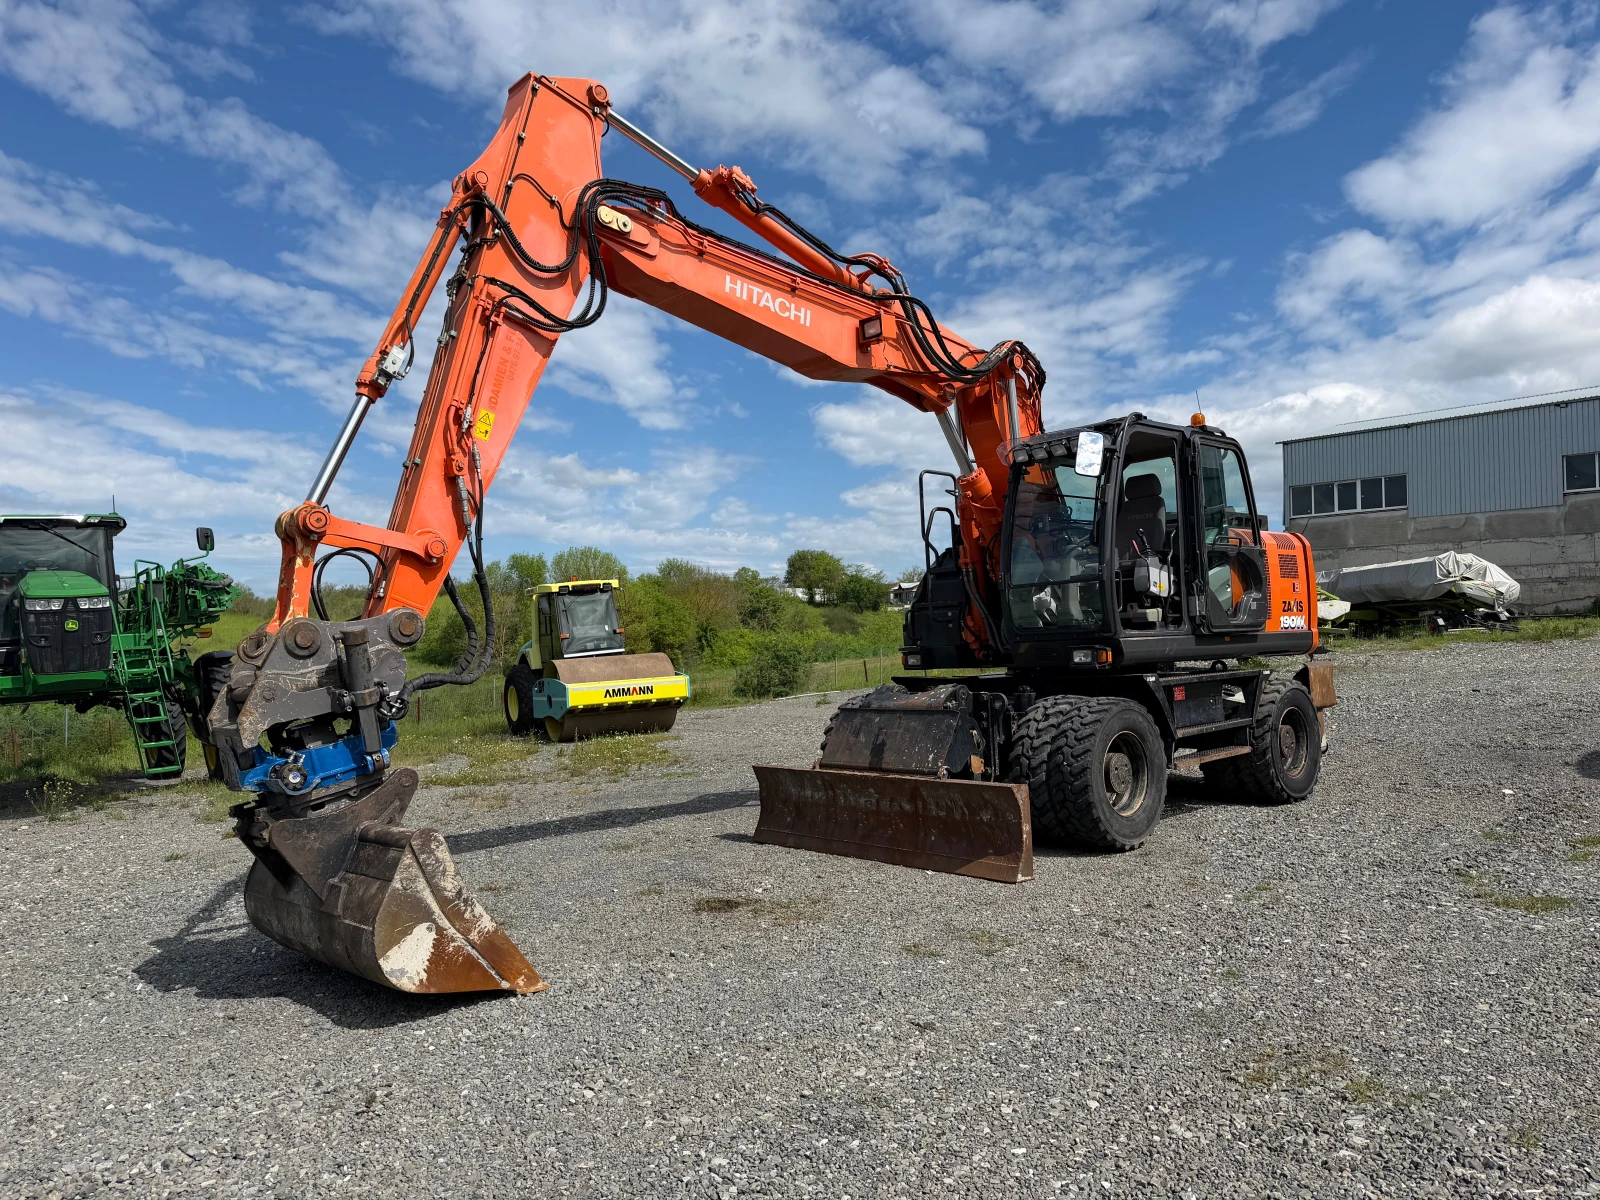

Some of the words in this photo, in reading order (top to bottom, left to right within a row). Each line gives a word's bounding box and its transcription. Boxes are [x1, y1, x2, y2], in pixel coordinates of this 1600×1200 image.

[725, 274, 811, 327] HITACHI
[512, 349, 520, 360] 97
[488, 357, 509, 406] DAMIEN
[502, 346, 512, 355] &
[507, 360, 518, 381] 0476
[1281, 598, 1304, 612] ZAXIS
[1279, 615, 1306, 629] 190W
[603, 685, 654, 698] AMMANN
